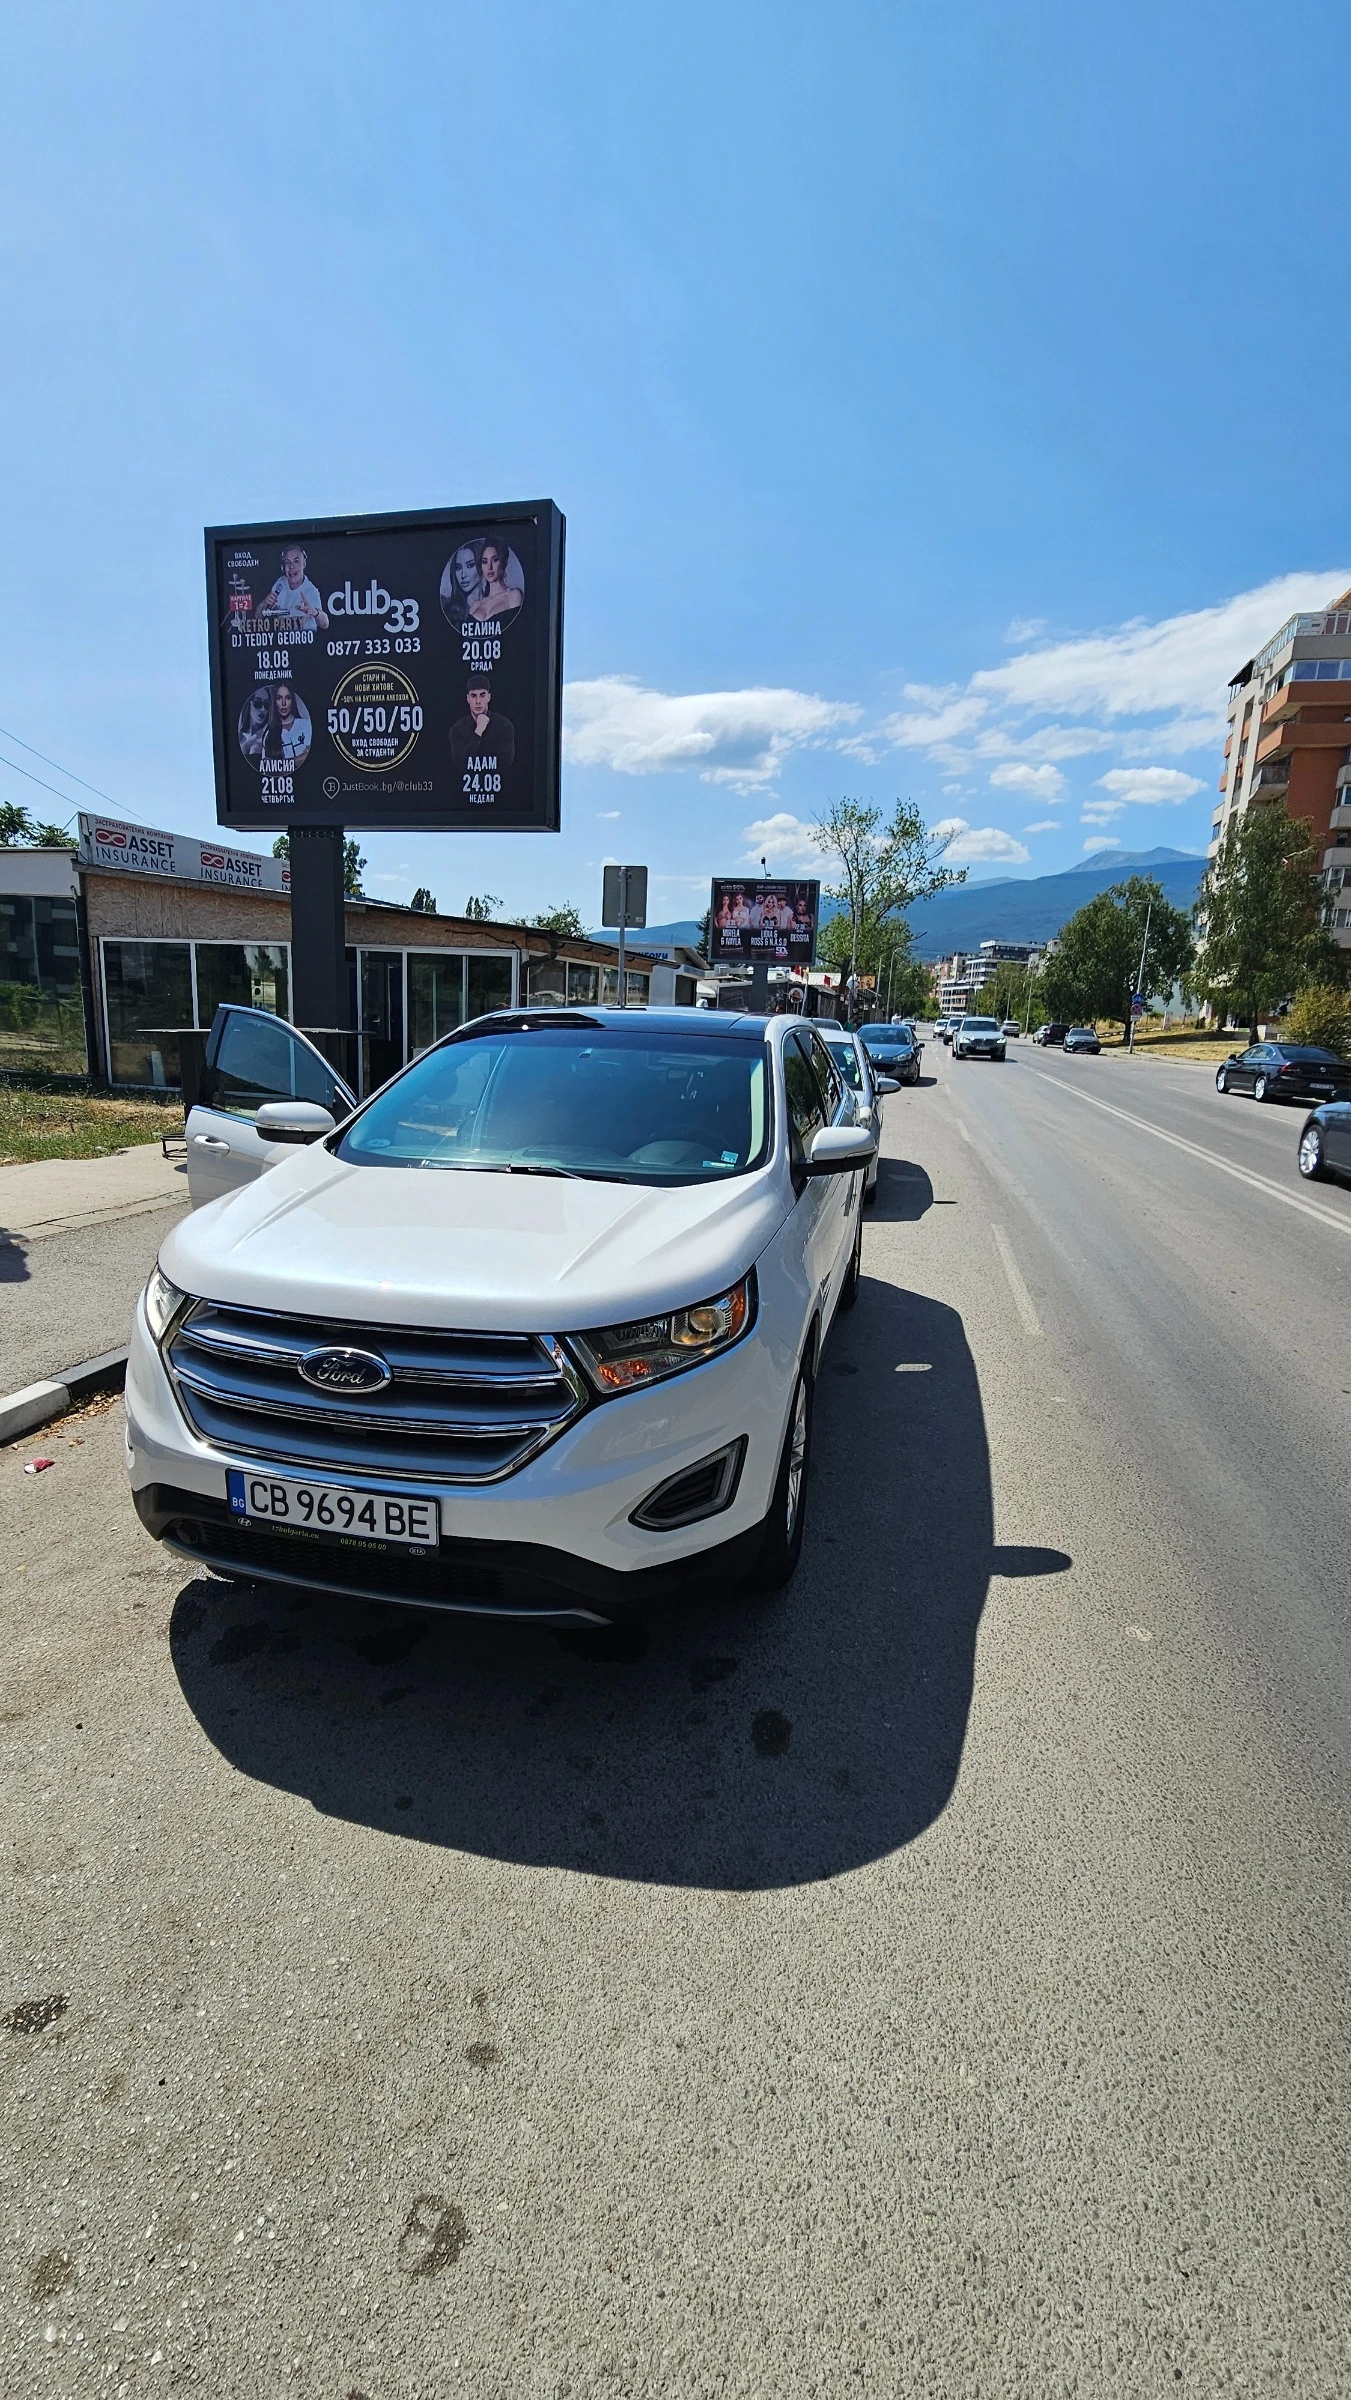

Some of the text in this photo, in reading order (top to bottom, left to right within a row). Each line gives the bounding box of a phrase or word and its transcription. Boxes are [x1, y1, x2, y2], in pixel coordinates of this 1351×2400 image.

[228, 560, 259, 568] СВОБОДЕН
[234, 601, 248, 610] 1=2
[239, 616, 305, 632] RETRO PARTY
[462, 621, 502, 636] СЕЛИНА
[232, 630, 314, 648] DJ TEDDY GEORGO
[327, 638, 420, 656] 0877 333 033
[462, 640, 501, 660] 20.08
[256, 650, 290, 669] 18.08
[470, 662, 492, 672] СРЯДА
[254, 670, 293, 680] ПОНЕДЕЛНИК
[362, 674, 386, 682] СТАРИ И
[354, 683, 394, 692] НОВИ ХИТОВЕ
[328, 706, 423, 734] 50/50/50
[352, 738, 398, 748] ВХОД СВОБОДЕН
[356, 748, 394, 758] ЗА СТУДЕНТИ
[260, 760, 294, 772] АЛИСИЯ
[468, 756, 497, 772] АДАМ
[262, 776, 294, 794] 21.08
[342, 781, 433, 793] JustBook.bg/@club33
[462, 774, 501, 792] 24.08
[262, 795, 294, 804] ЧЕТВЪРТЪК
[470, 794, 494, 804] НЕДЕЛЯ
[129, 836, 174, 858] ASSET
[96, 846, 176, 872] INSURANCE
[226, 858, 262, 877] ASSET
[201, 868, 262, 887] INSURANCE
[317, 1358, 366, 1384] Ford
[232, 1497, 244, 1508] BG
[296, 1490, 376, 1532] 9694
[340, 1538, 356, 1546] 0878
